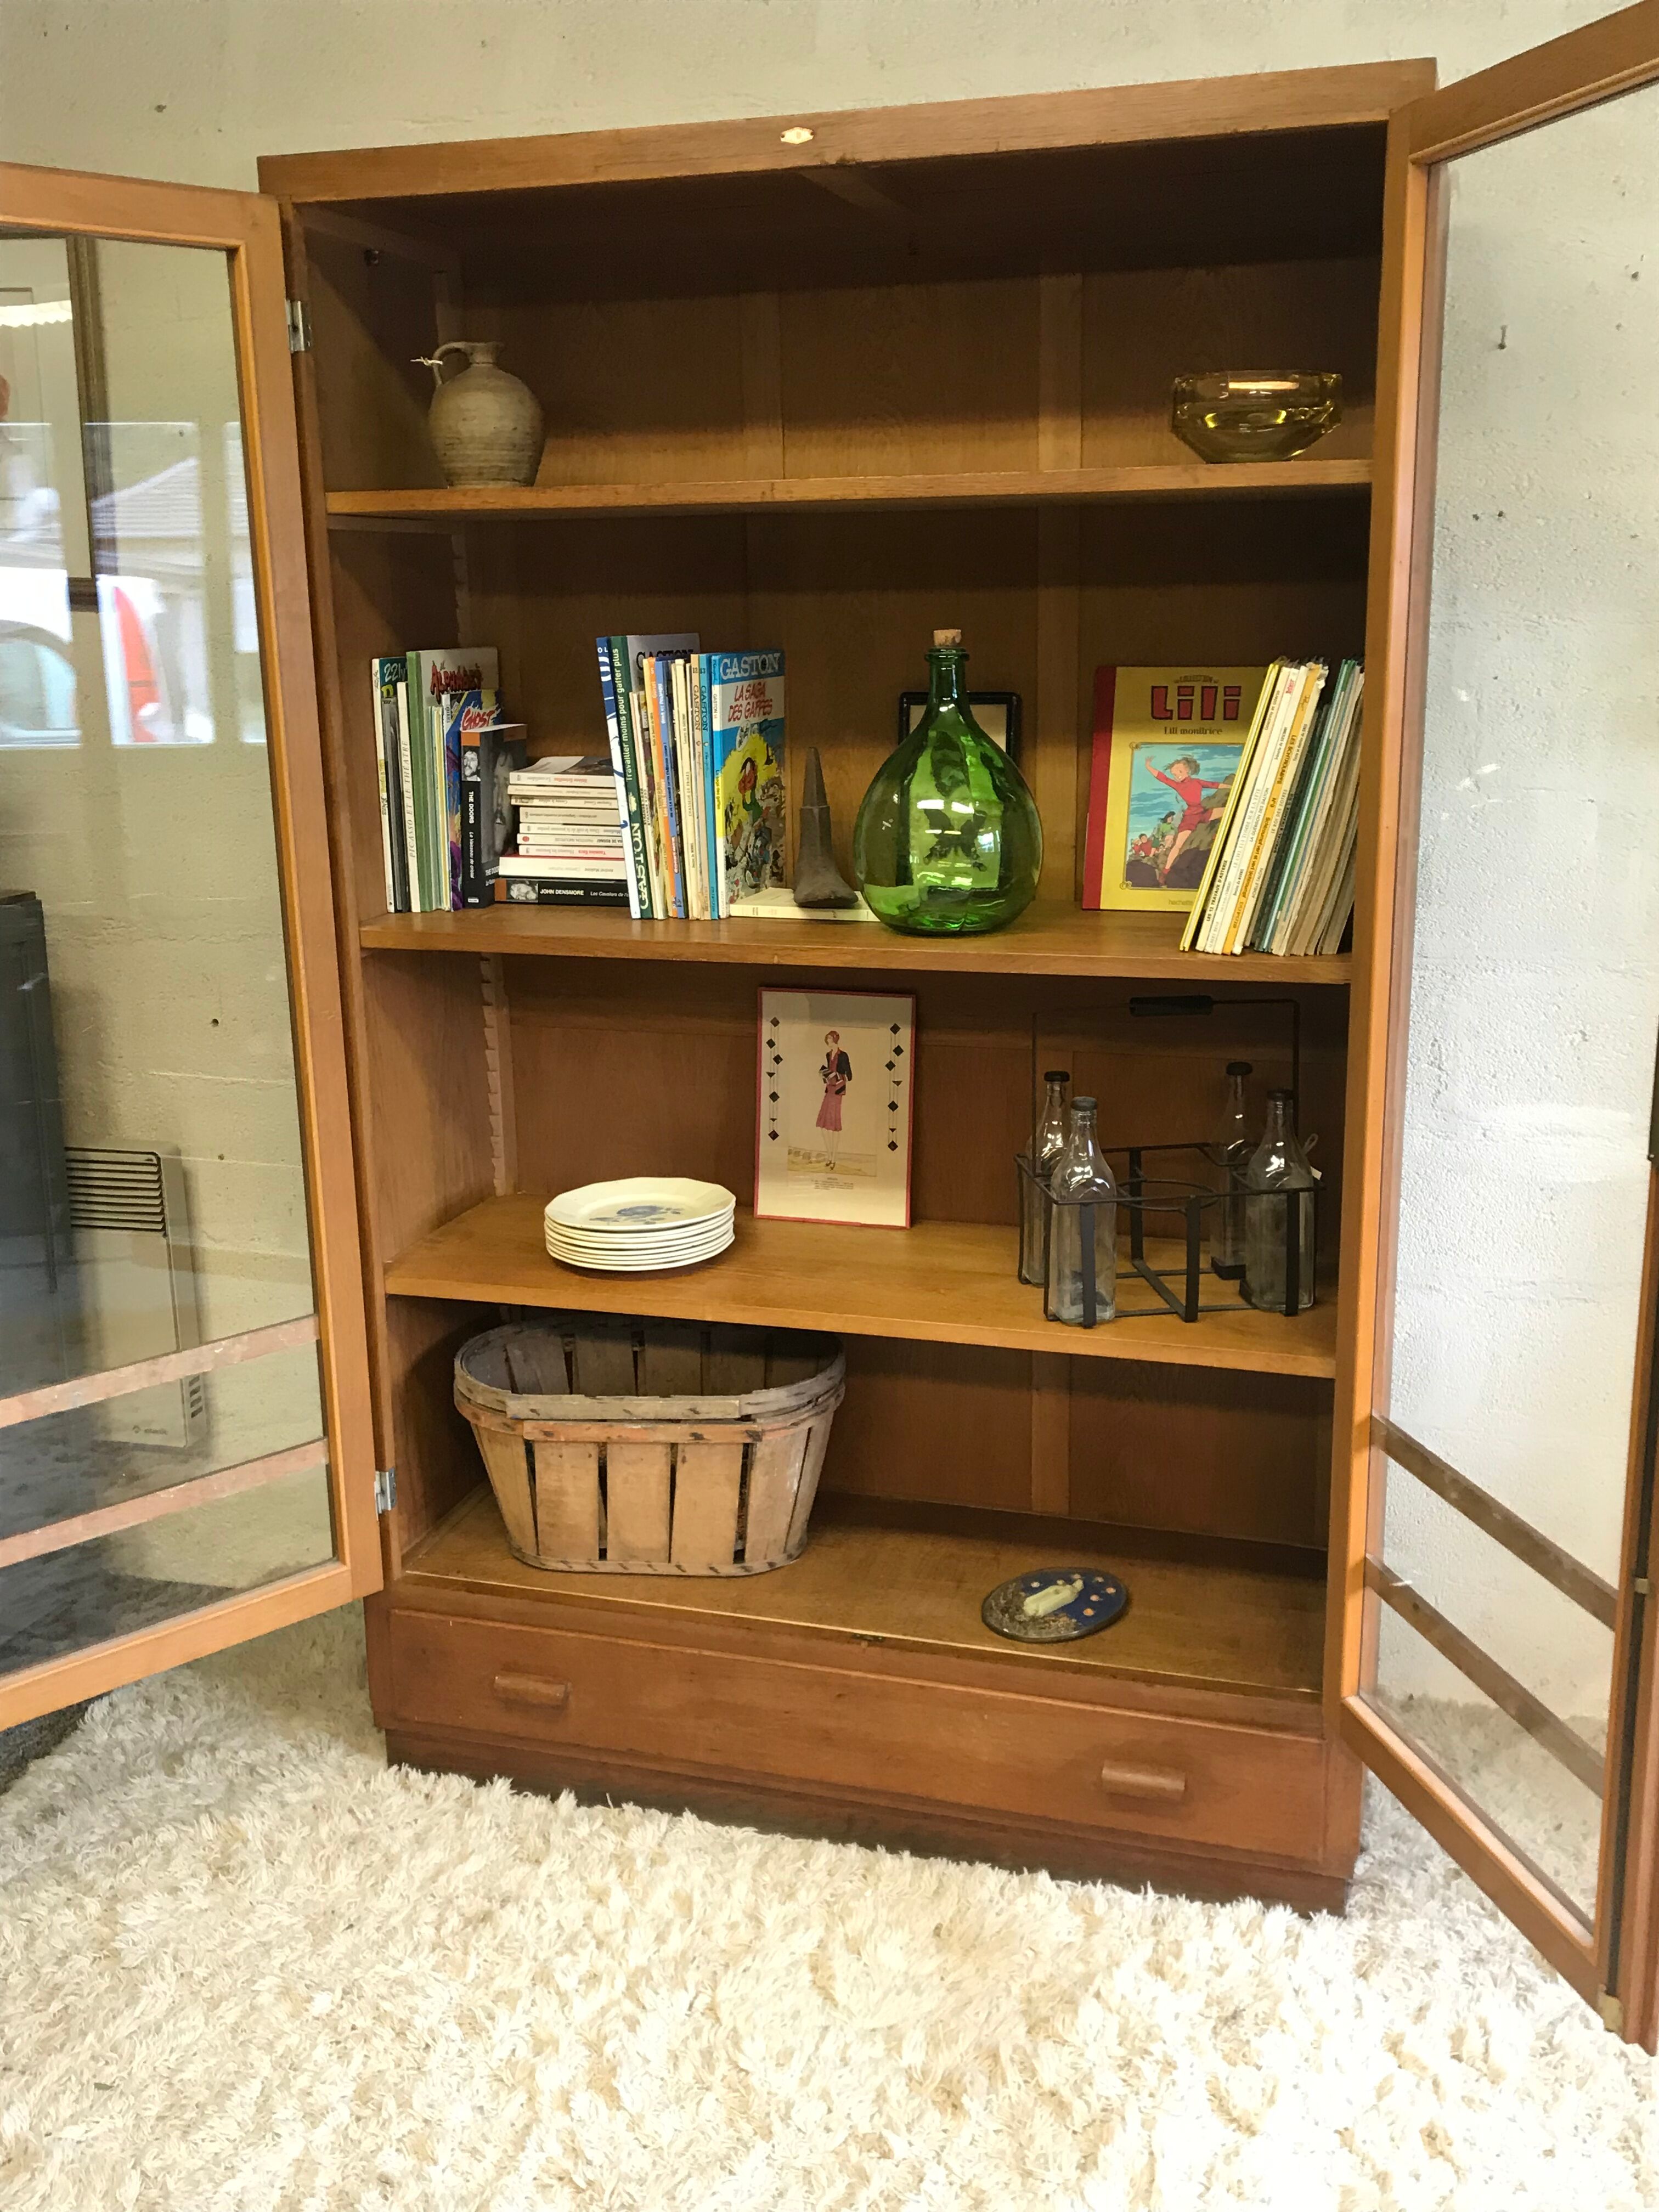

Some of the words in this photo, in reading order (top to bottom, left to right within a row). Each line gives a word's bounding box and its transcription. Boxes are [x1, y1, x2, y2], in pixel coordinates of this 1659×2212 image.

[612, 648, 620, 667] plus
[720, 653, 781, 680] GASTON
[616, 667, 625, 693] gaffer
[733, 685, 744, 702] LA
[745, 681, 766, 699] SAGA
[618, 696, 627, 716] pour
[728, 704, 743, 723] DES
[744, 699, 773, 719] GAFFES
[461, 708, 495, 731] GHOST
[1180, 726, 1223, 735] monitrice
[623, 742, 633, 781] Travailler
[406, 820, 415, 857] PICASSO
[1210, 883, 1221, 906] TRAVAUX
